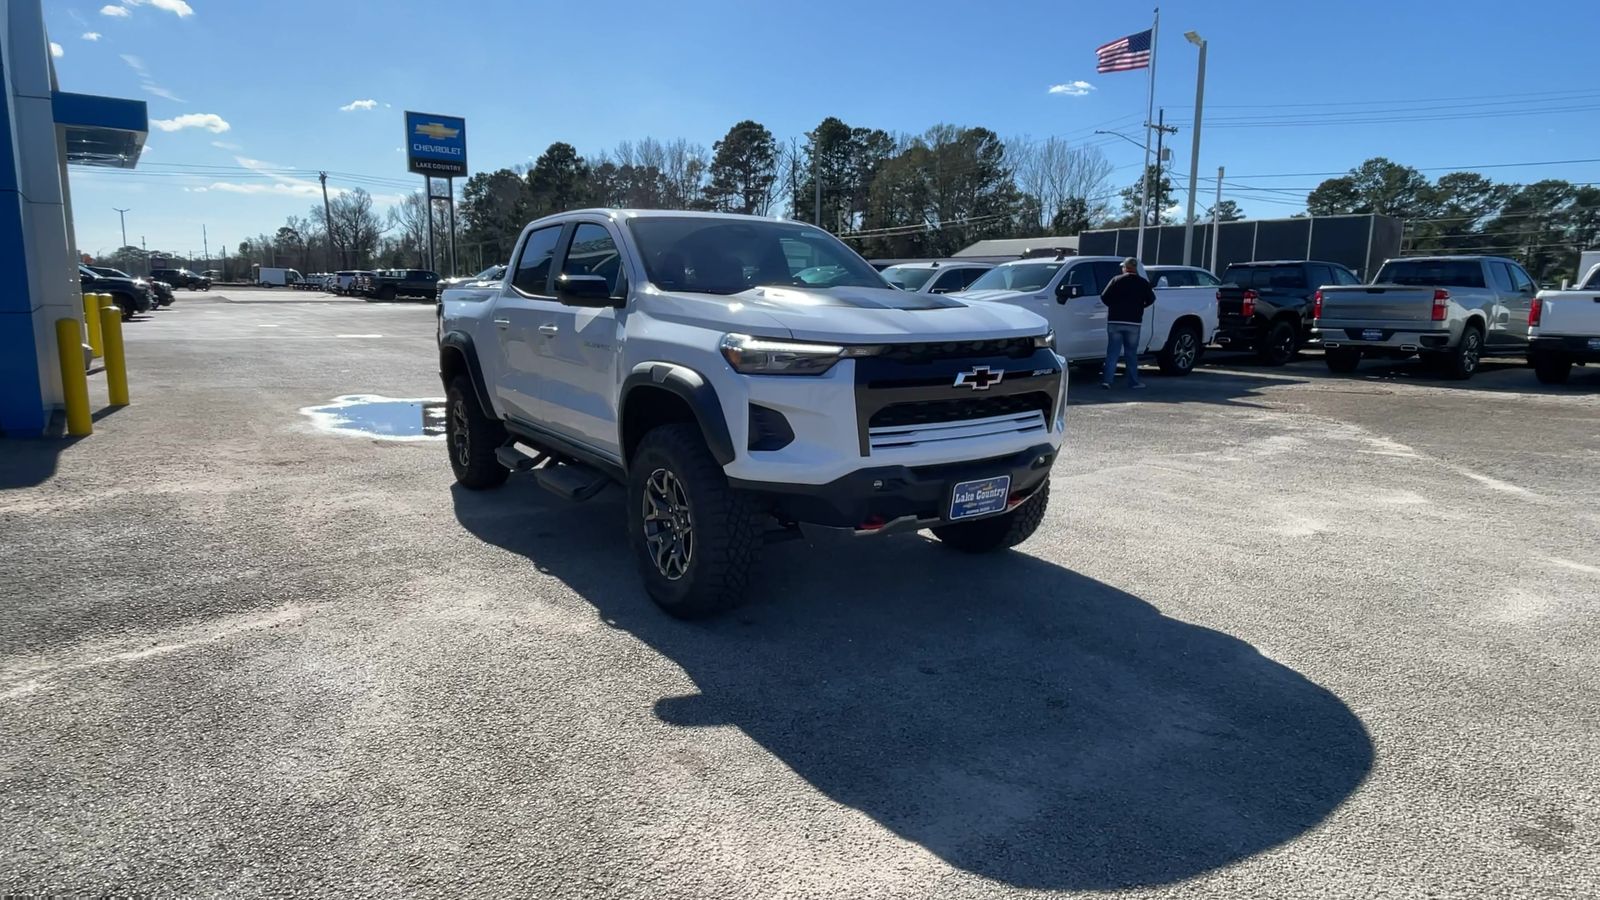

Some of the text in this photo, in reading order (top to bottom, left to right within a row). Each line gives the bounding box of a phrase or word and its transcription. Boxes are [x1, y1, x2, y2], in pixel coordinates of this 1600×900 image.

[413, 143, 461, 155] CHEVROLET
[432, 163, 461, 171] COUNTRY
[955, 492, 975, 503] Lake
[976, 488, 1006, 500] Country
